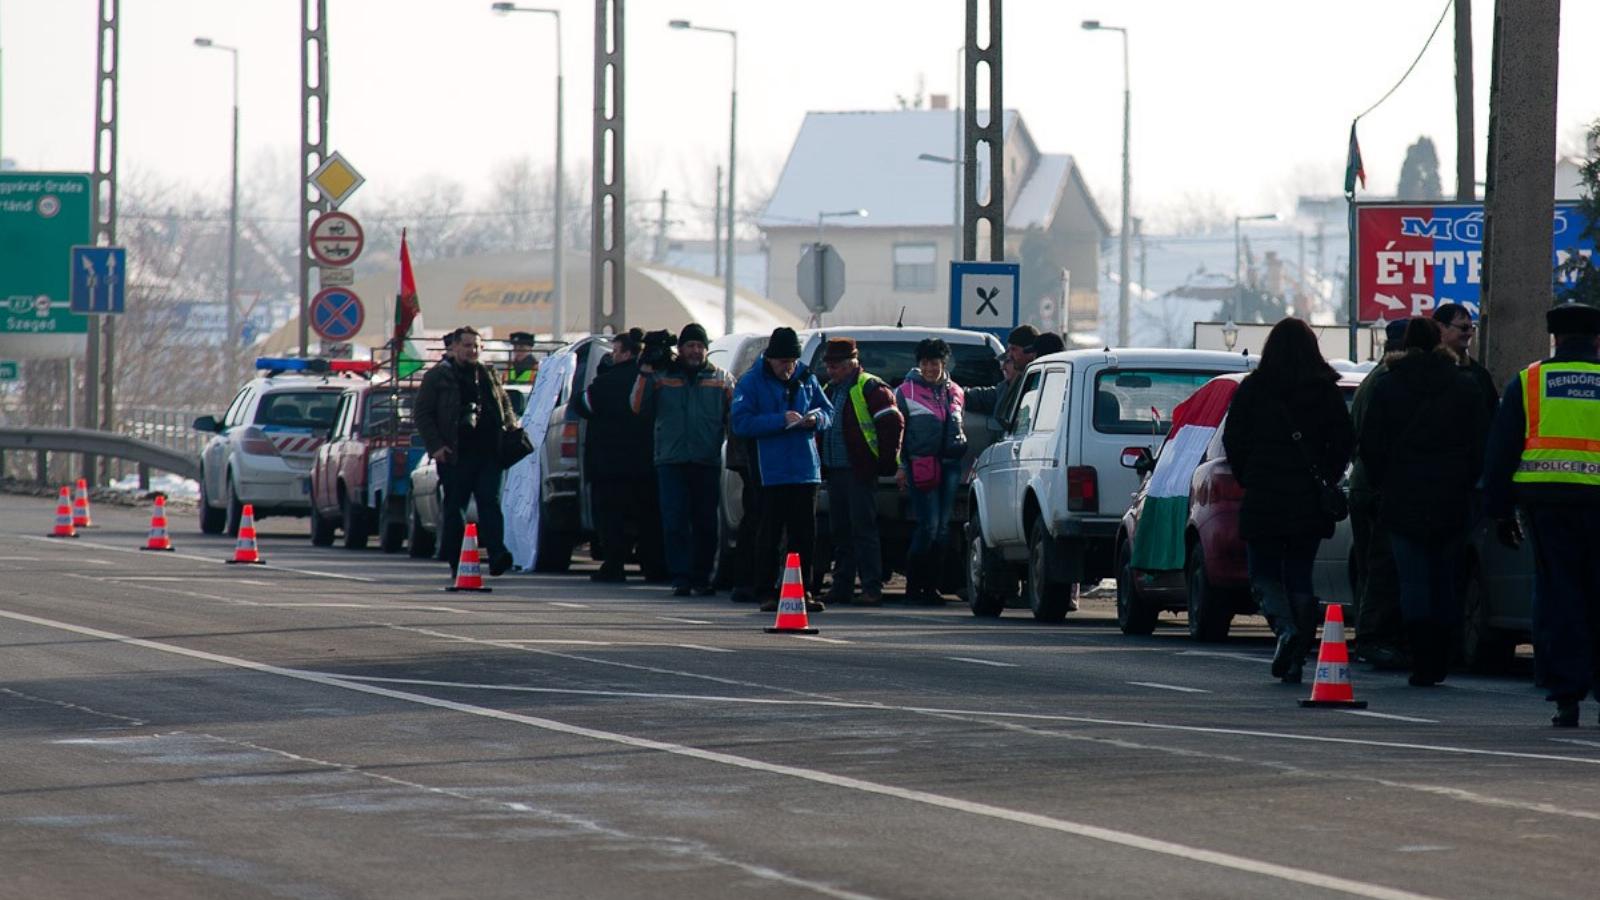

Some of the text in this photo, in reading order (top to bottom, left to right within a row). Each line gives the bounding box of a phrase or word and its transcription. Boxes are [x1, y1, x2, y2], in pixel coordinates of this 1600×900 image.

[7, 316, 56, 332] Szeged
[1568, 389, 1595, 398] POLICE
[1535, 461, 1577, 472] POLICE
